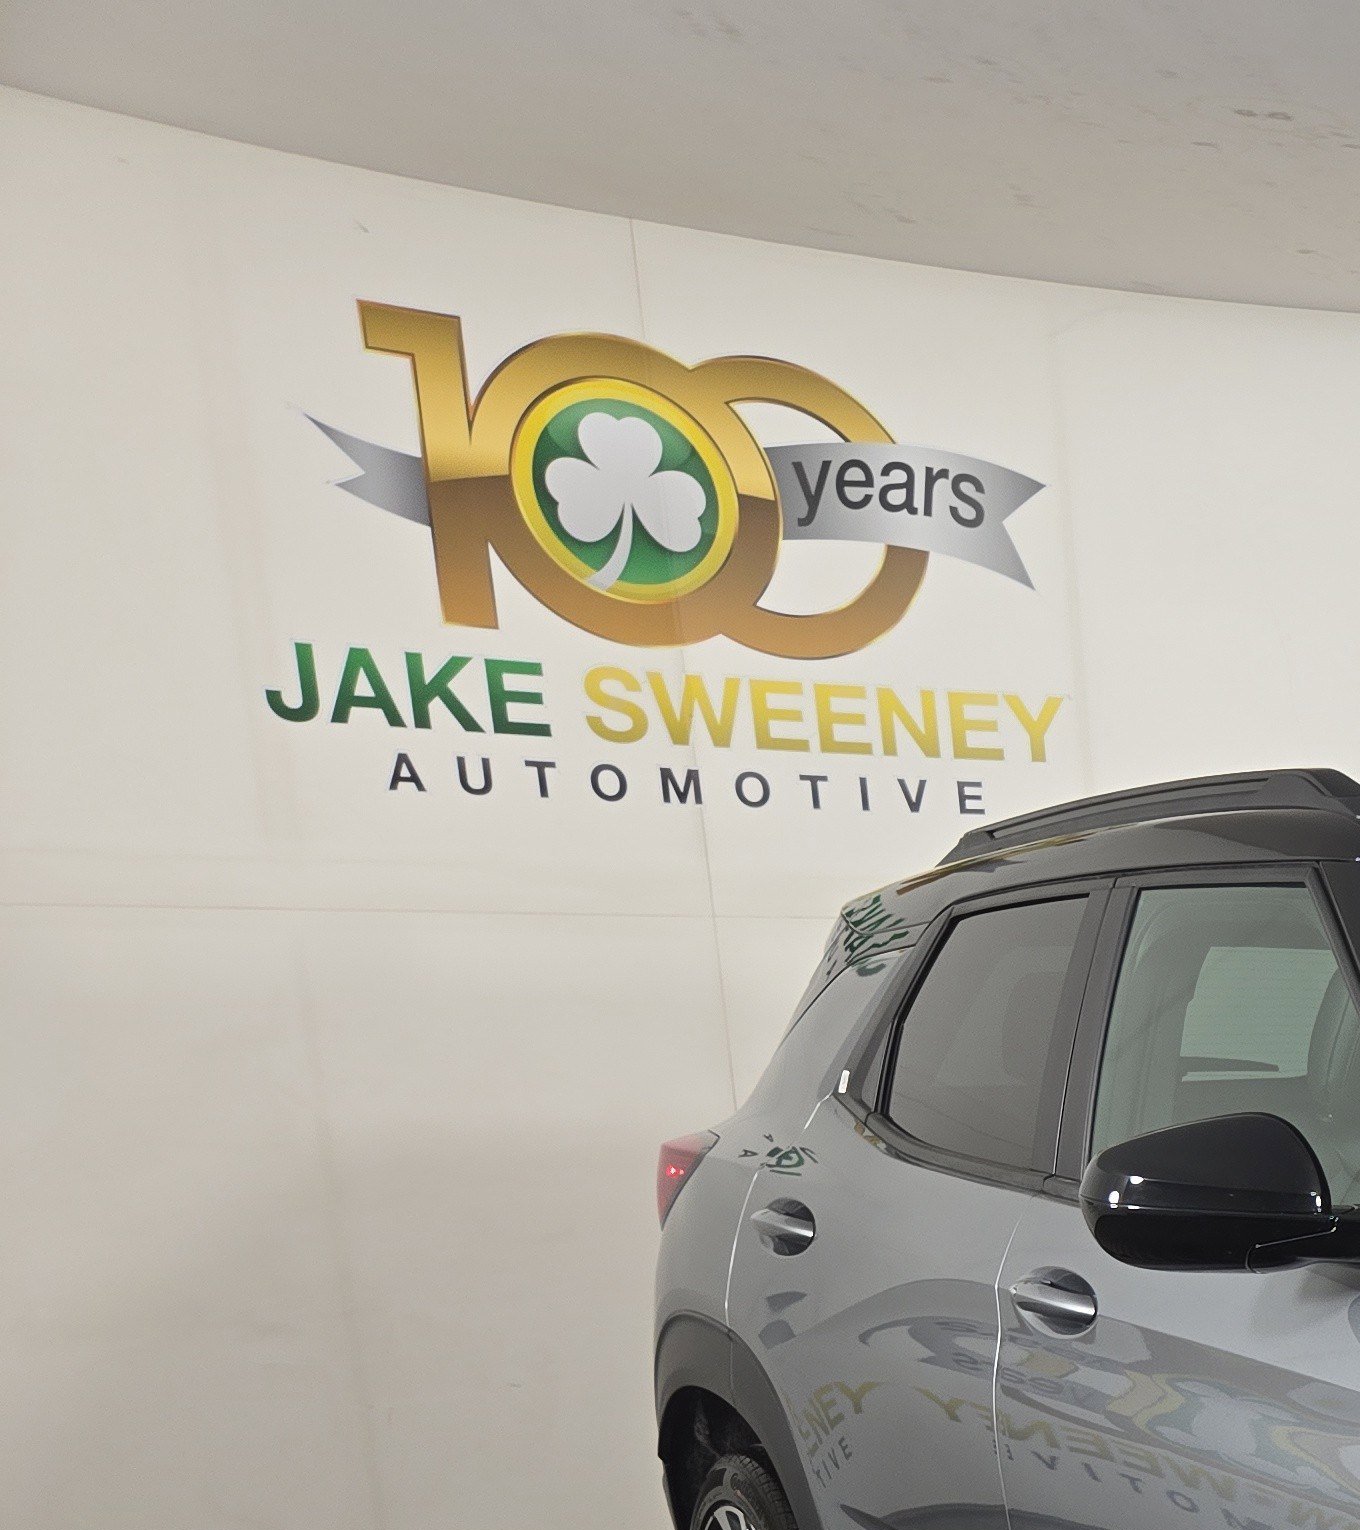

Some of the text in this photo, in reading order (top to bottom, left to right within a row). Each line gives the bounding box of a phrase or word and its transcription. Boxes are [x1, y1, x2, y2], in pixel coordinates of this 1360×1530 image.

[355, 298, 931, 660] 100
[792, 456, 987, 529] years
[265, 641, 1063, 763] JAKE SWEENEY
[388, 752, 986, 815] AUTOMOTIVE
